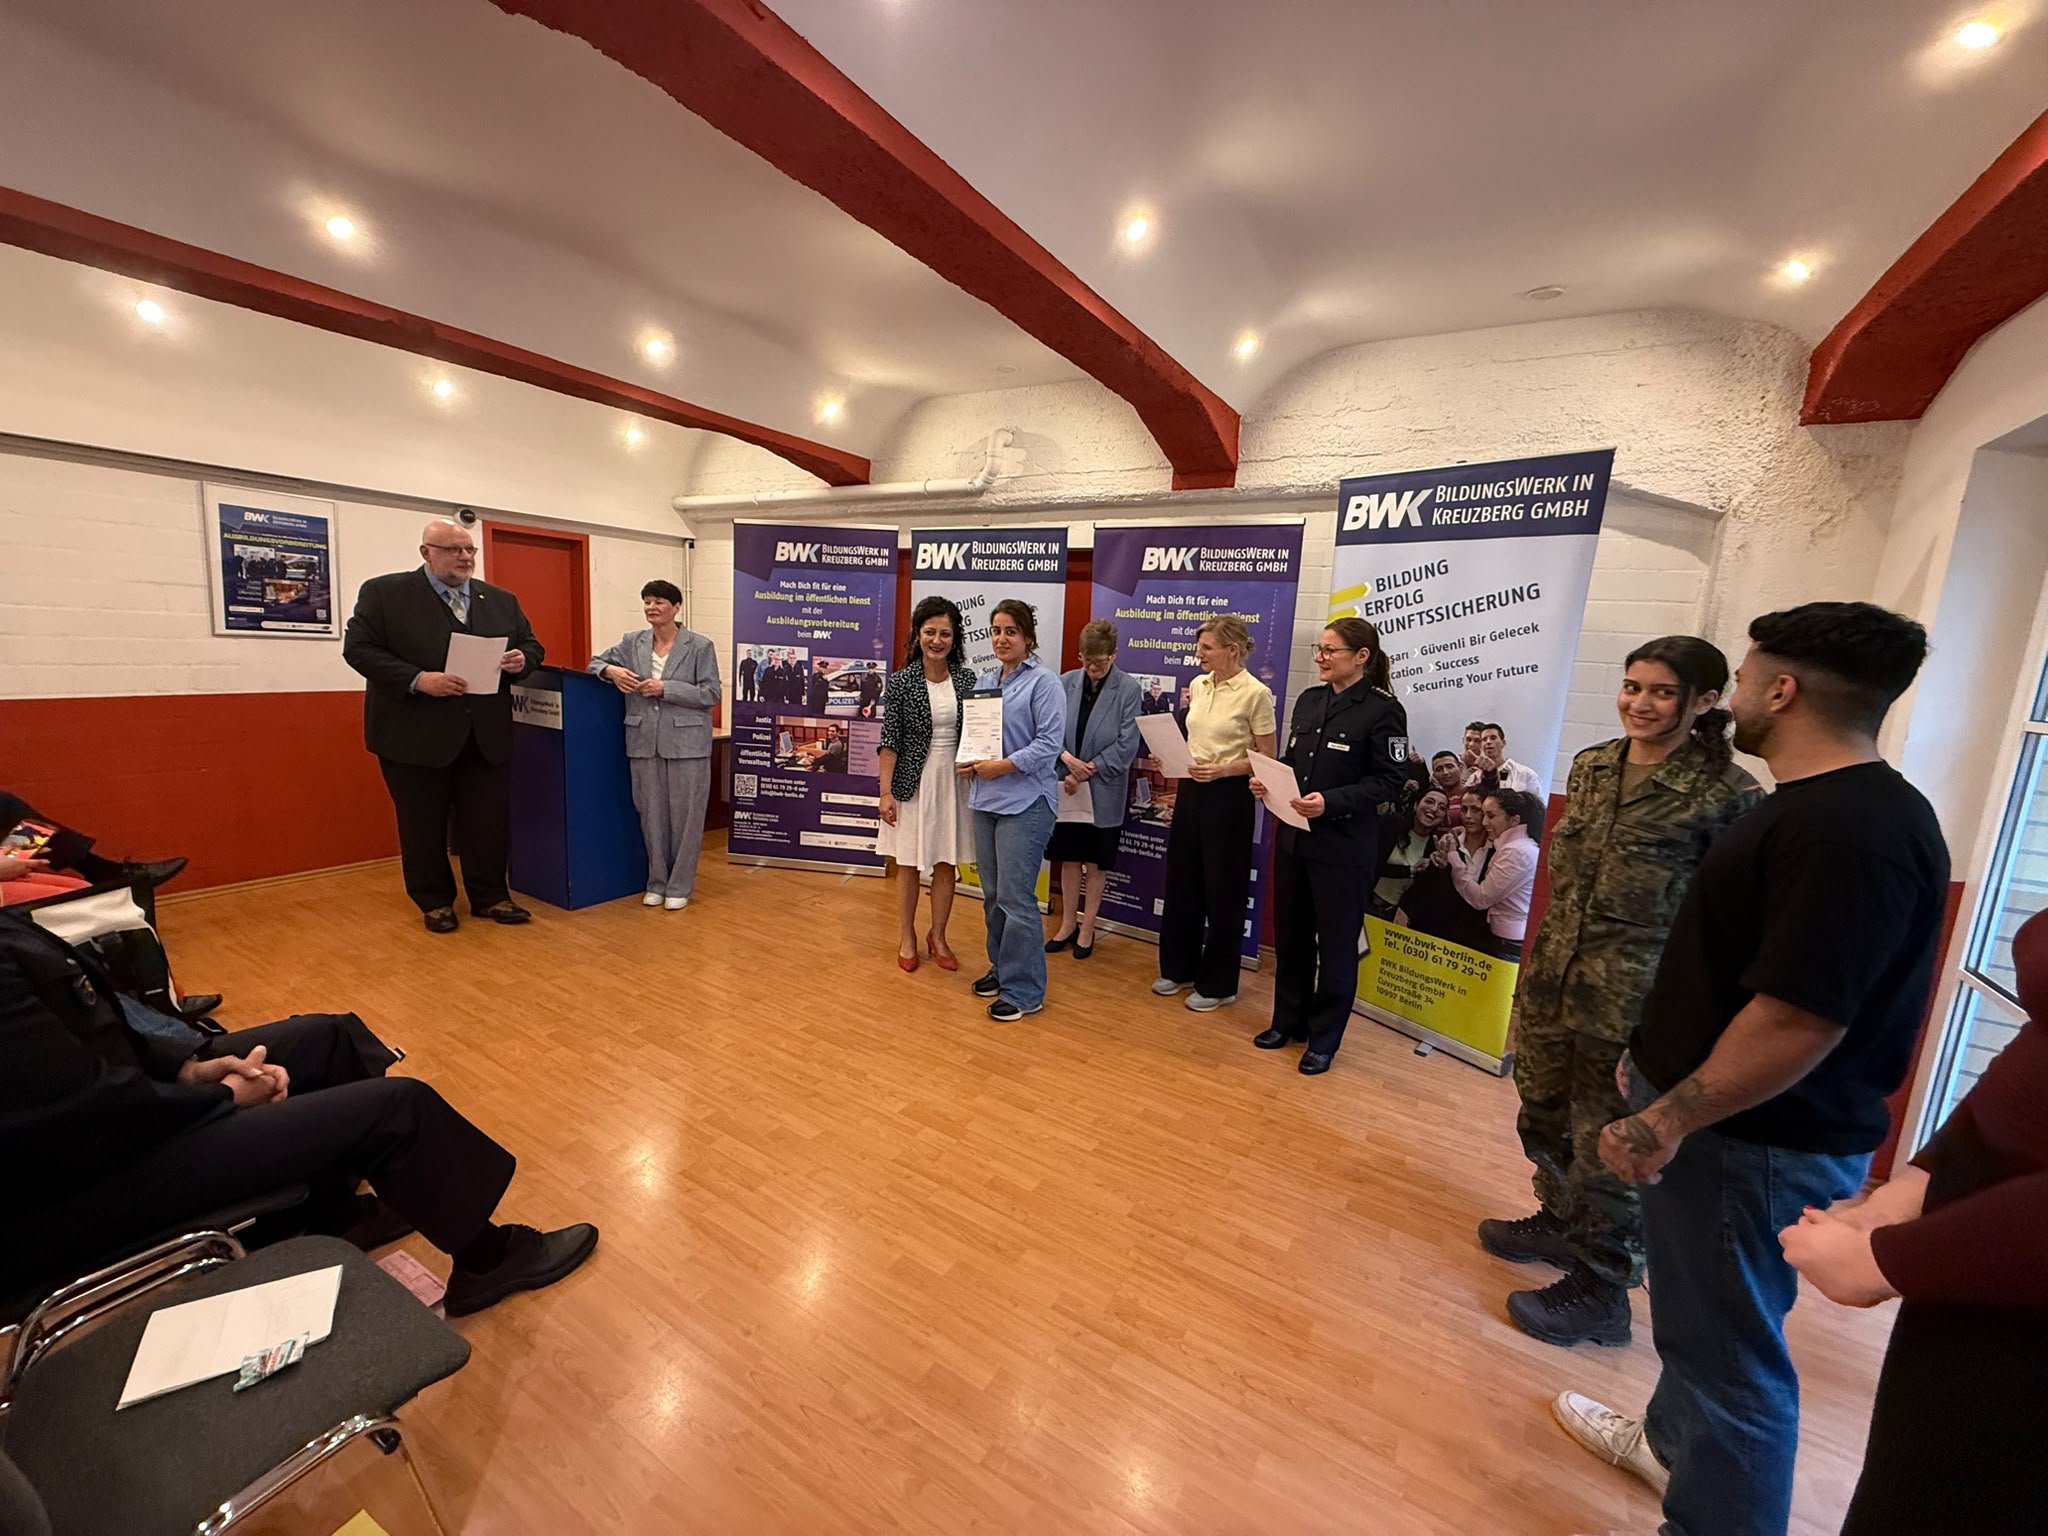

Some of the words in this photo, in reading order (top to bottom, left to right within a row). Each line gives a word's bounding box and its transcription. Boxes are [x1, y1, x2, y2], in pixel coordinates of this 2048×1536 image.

[1572, 473, 1594, 492] IN
[244, 511, 270, 523] BWK
[1342, 488, 1434, 531] BWK
[1432, 503, 1524, 526] KREUZBERG
[775, 541, 821, 563] BWK
[880, 548, 889, 556] IN
[916, 542, 971, 570] BWK
[1048, 542, 1060, 555] IN
[1278, 548, 1289, 560] IN
[971, 557, 1024, 571] KREUZBERG
[1141, 547, 1199, 572] BWK
[1199, 560, 1253, 572] KREUZBERG
[1376, 559, 1449, 592] BILDUNG
[780, 580, 796, 589] Mach
[798, 581, 811, 589] Dich
[812, 582, 820, 590] fit
[821, 583, 831, 591] für
[832, 583, 846, 592] eine
[754, 590, 793, 602] Ausbildung
[795, 592, 804, 601] im
[806, 593, 847, 604] öffentlichen
[849, 596, 871, 605] Dienst
[956, 594, 985, 612] DUNG
[1146, 595, 1165, 604] Mach
[1168, 595, 1183, 605] Dich
[1185, 595, 1195, 605] fit
[1197, 596, 1209, 606] für
[1211, 597, 1228, 606] eine
[1365, 589, 1424, 616] ERFOLG
[802, 606, 811, 614] mit
[813, 607, 823, 615] der
[1115, 608, 1162, 621] Ausbildung
[1164, 609, 1174, 619] im
[1373, 583, 1541, 636] KUNFTSSICHERUNG
[766, 616, 859, 631] Ausbildungsvorbereitung
[1171, 627, 1183, 635] mit
[797, 630, 812, 638] beim
[812, 630, 832, 639] BWK
[1128, 638, 1200, 652] Ausbildungsvor
[1390, 651, 1409, 664] şarı
[1420, 637, 1465, 656] Güvenli
[1469, 633, 1487, 646] Bir
[1489, 622, 1540, 642] Gelecek
[972, 653, 997, 664] Güven
[1164, 655, 1181, 664] beim
[1182, 655, 1201, 667] BW
[1391, 665, 1423, 680] cation
[1435, 655, 1480, 671] Success
[1412, 676, 1464, 693] Securing
[1466, 671, 1493, 684] Your
[1496, 663, 1539, 679] Future
[512, 694, 530, 714] WK
[755, 716, 772, 724] Justiz
[752, 733, 772, 741] Polizei
[740, 749, 771, 758] öffentliche
[738, 758, 771, 768] Verwaltung
[1384, 928, 1492, 971] www.bwk-berlin.de
[1384, 937, 1400, 951] Tel.
[1402, 943, 1429, 962] (030)
[1431, 954, 1443, 965] 61
[1446, 959, 1459, 970] 79
[1461, 964, 1488, 982] 29-0
[1379, 967, 1418, 990] Kreuzberg
[1419, 983, 1446, 998] GmbH
[1398, 963, 1456, 992] BildungsWerk
[1457, 986, 1467, 996] in
[1376, 985, 1398, 1000] 10997
[1398, 996, 1423, 1011] Berlin
[1377, 976, 1422, 1001] Cuvrystraße
[1423, 995, 1434, 1005] 34
